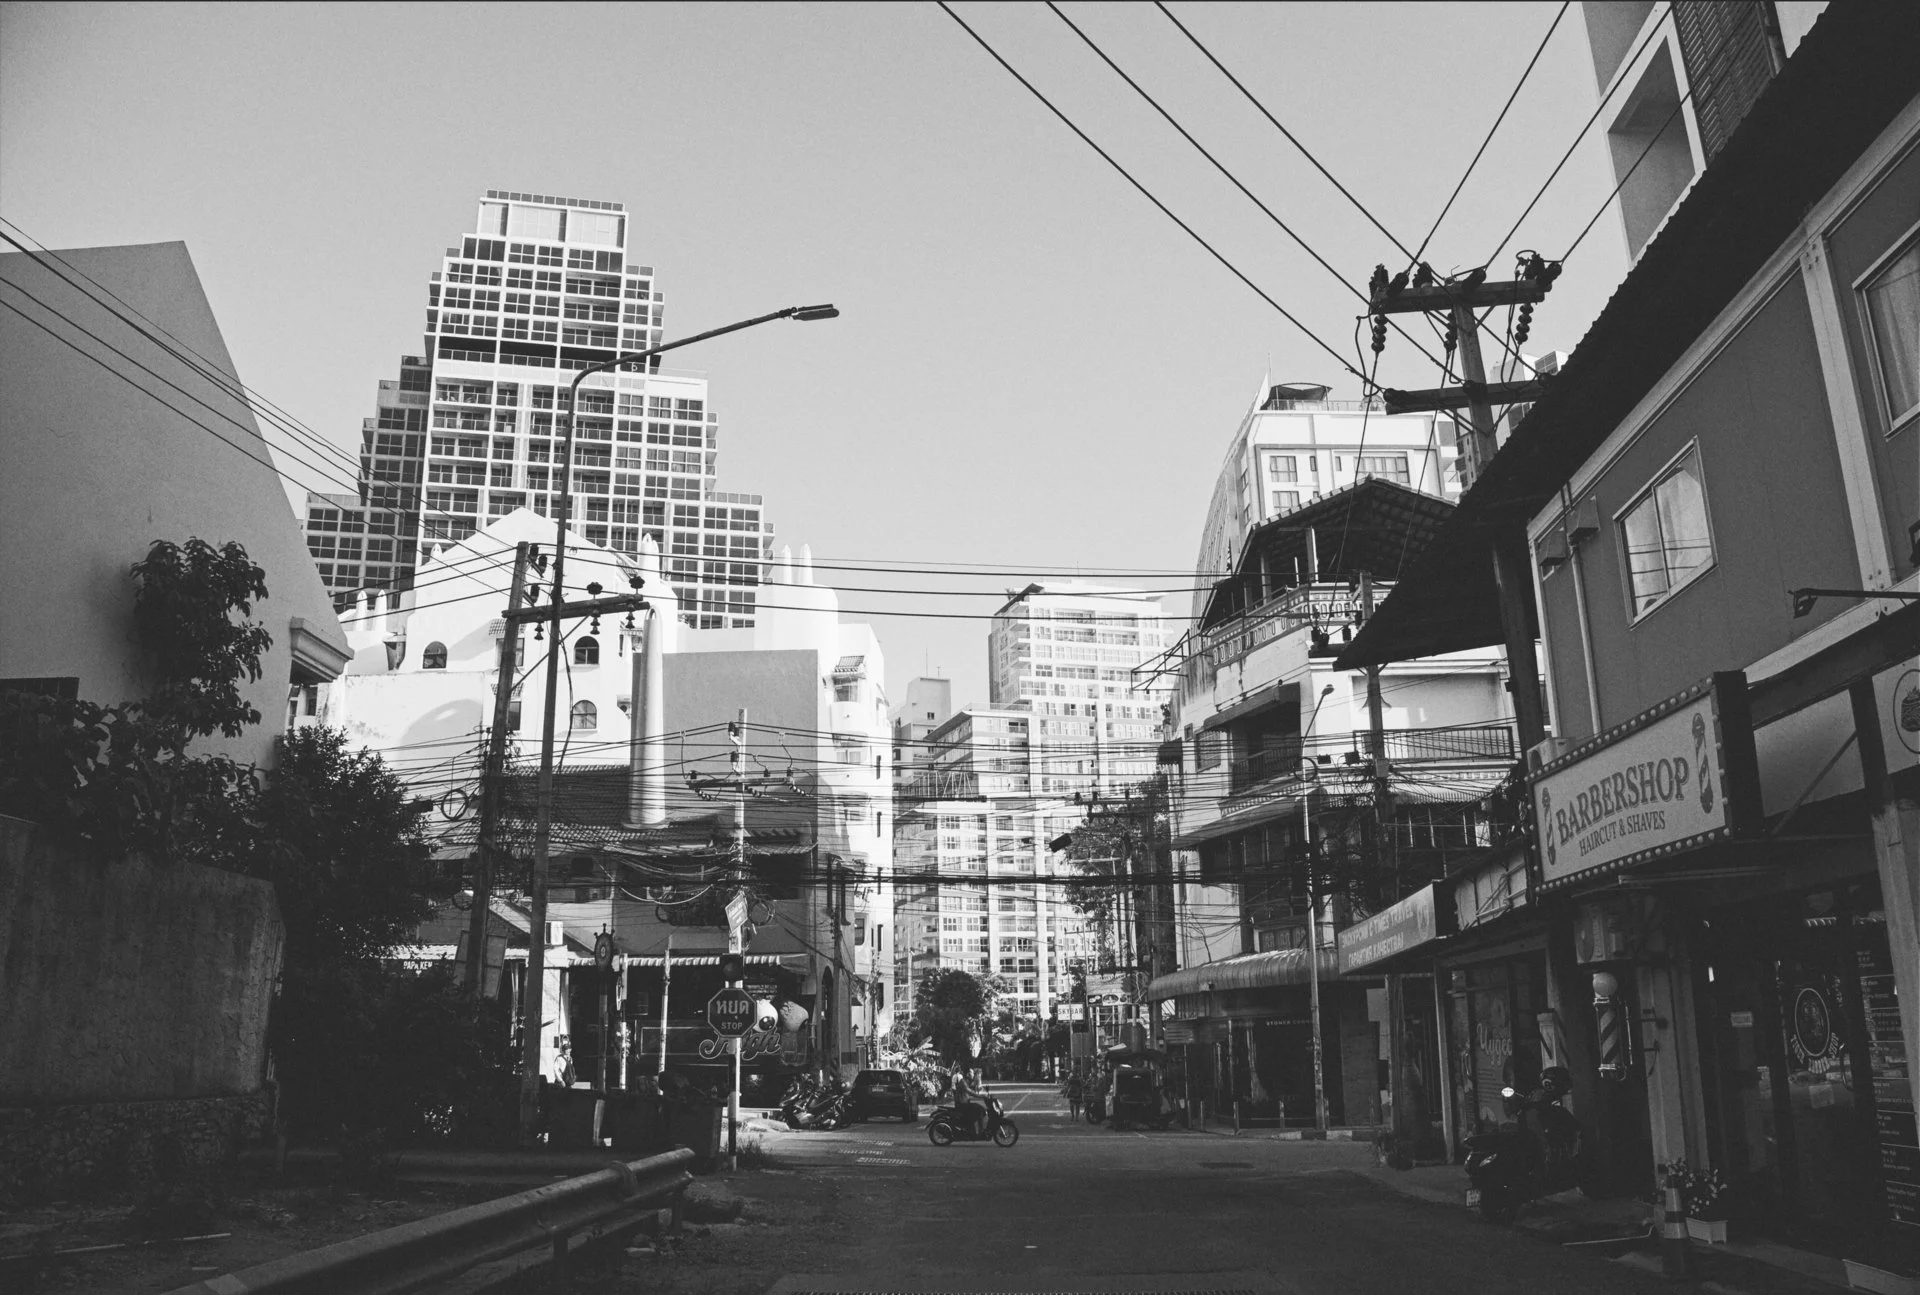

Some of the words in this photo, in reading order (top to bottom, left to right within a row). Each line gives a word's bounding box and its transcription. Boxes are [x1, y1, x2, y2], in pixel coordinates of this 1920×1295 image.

[1556, 757, 1690, 847] BARBERSHOP
[1579, 821, 1618, 857] HAIRCUT
[1619, 820, 1626, 836] &
[1627, 811, 1666, 835] SHAVES
[716, 1000, 749, 1020] หยุด
[721, 1022, 743, 1030] STOP
